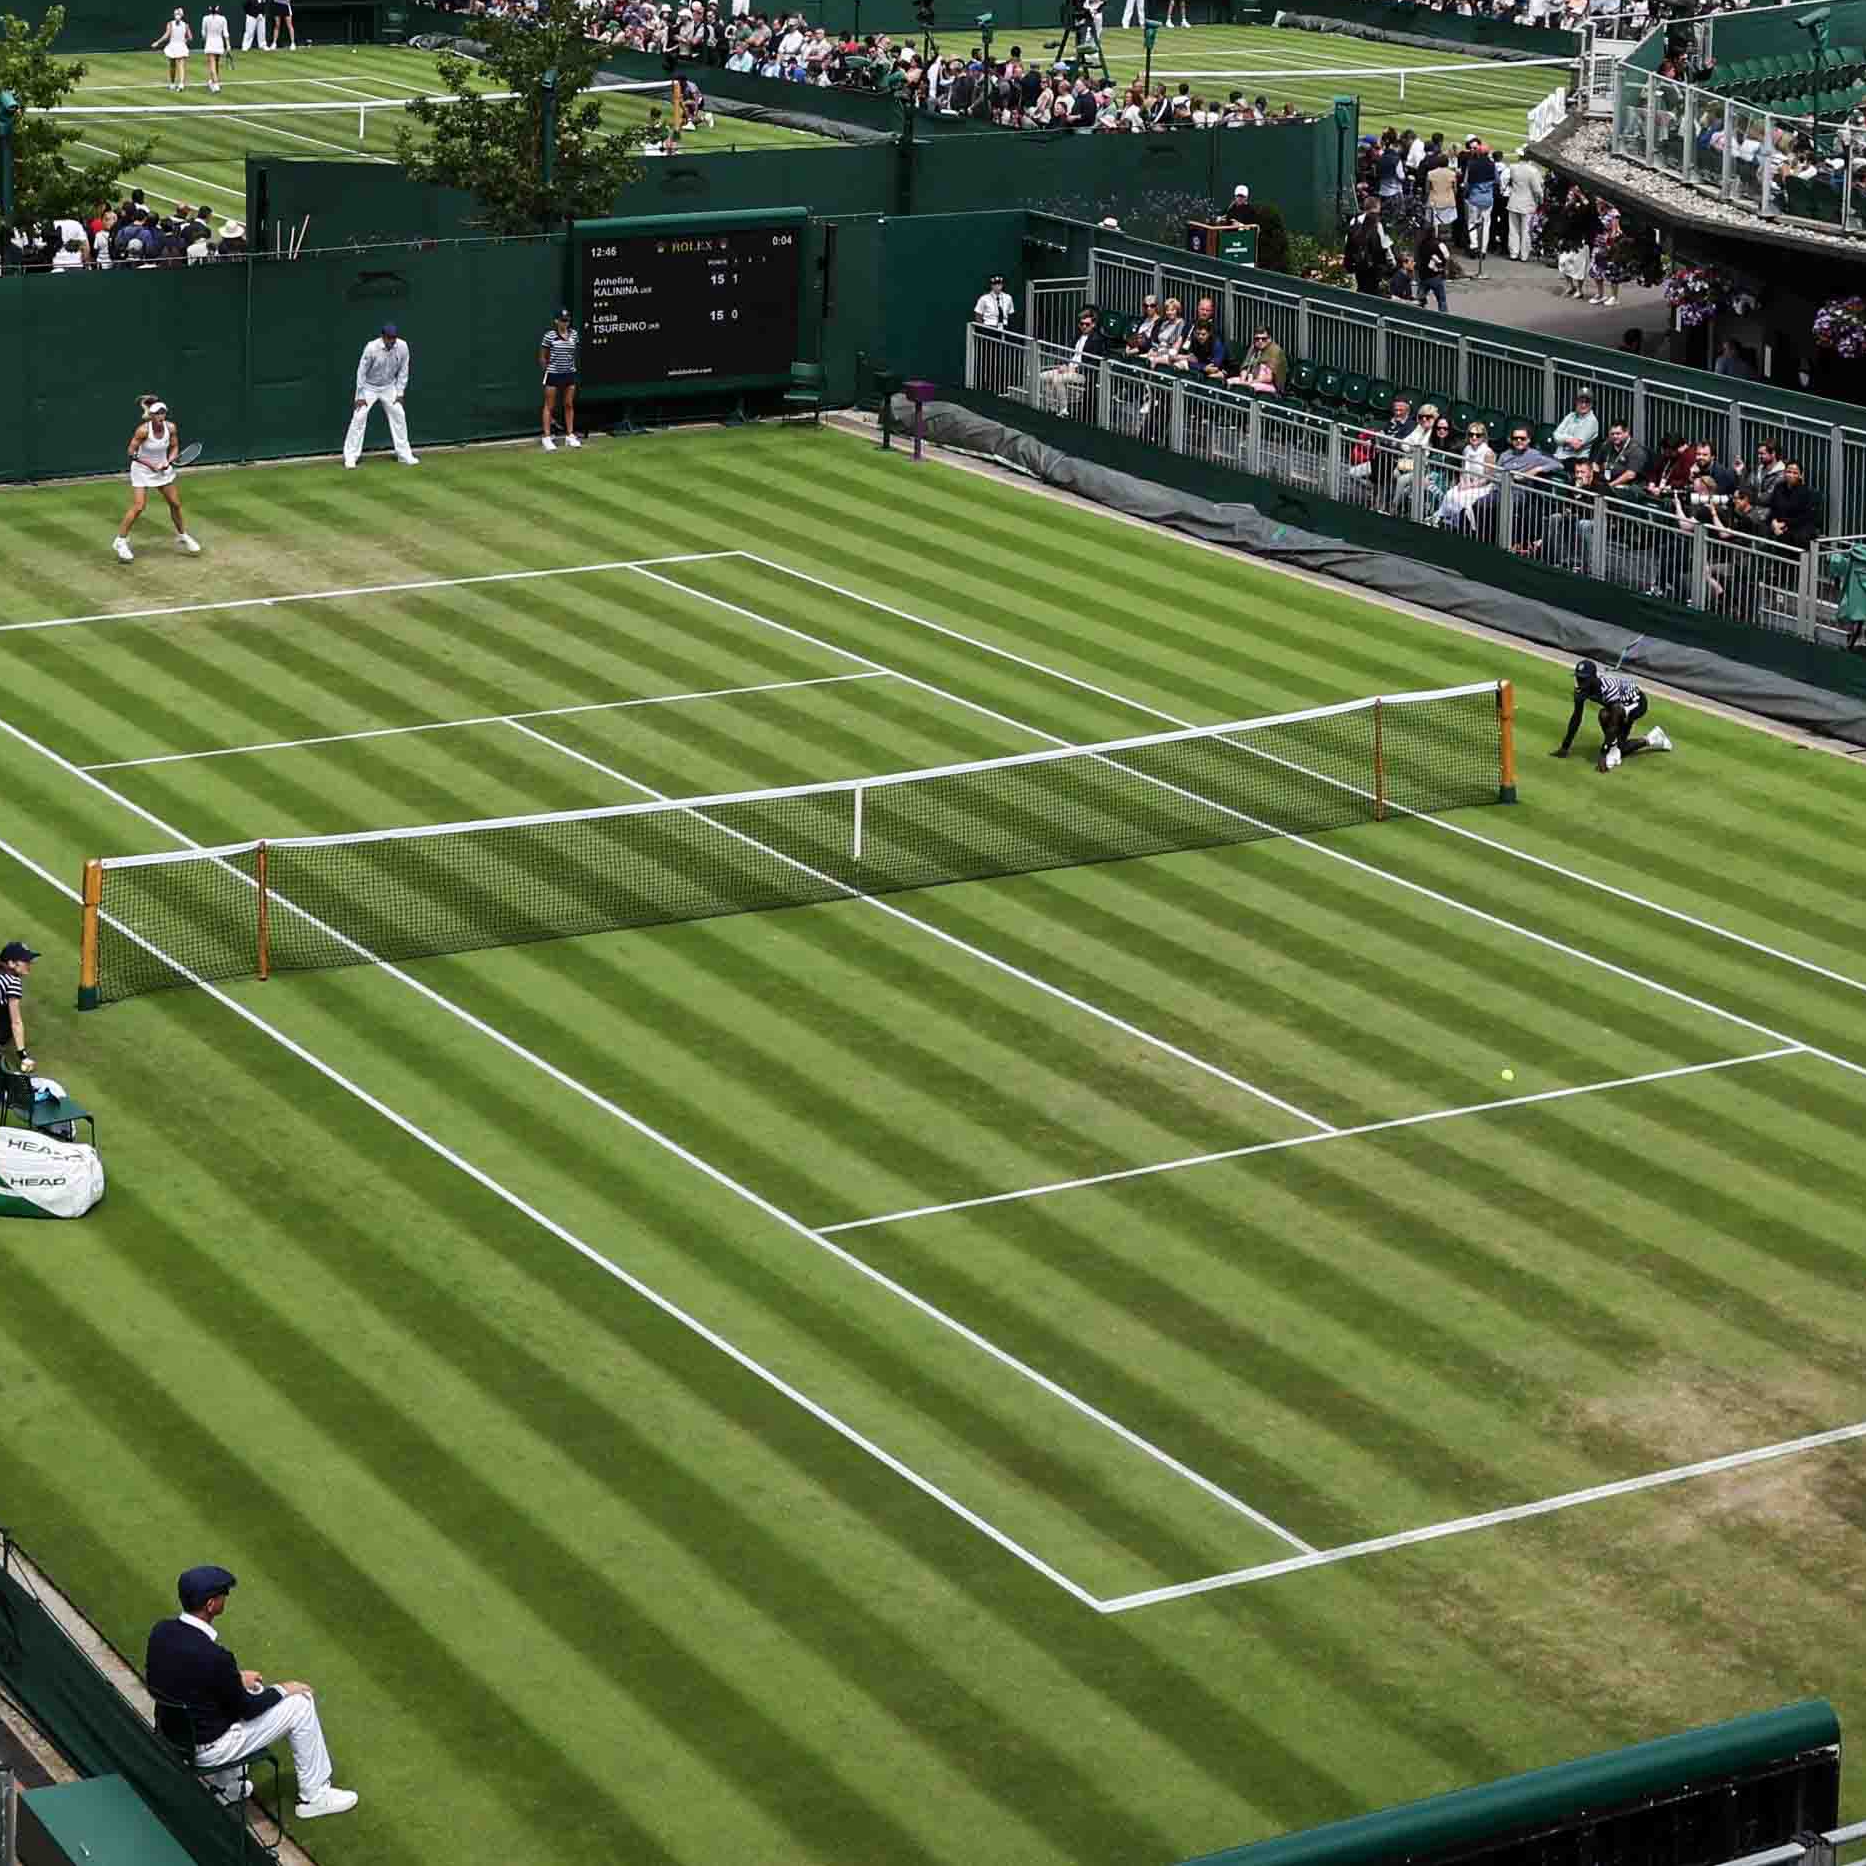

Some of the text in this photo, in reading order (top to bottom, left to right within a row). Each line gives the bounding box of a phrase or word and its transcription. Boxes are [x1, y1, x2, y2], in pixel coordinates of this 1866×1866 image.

[671, 240, 713, 253] ROLEX
[772, 235, 792, 246] 0:04
[594, 274, 738, 287] Anhelina 15 1
[593, 285, 639, 296] KALININA
[592, 310, 739, 324] Lesia 15 0
[593, 321, 647, 334] TSURENKO
[10, 1177, 66, 1187] HEAD
